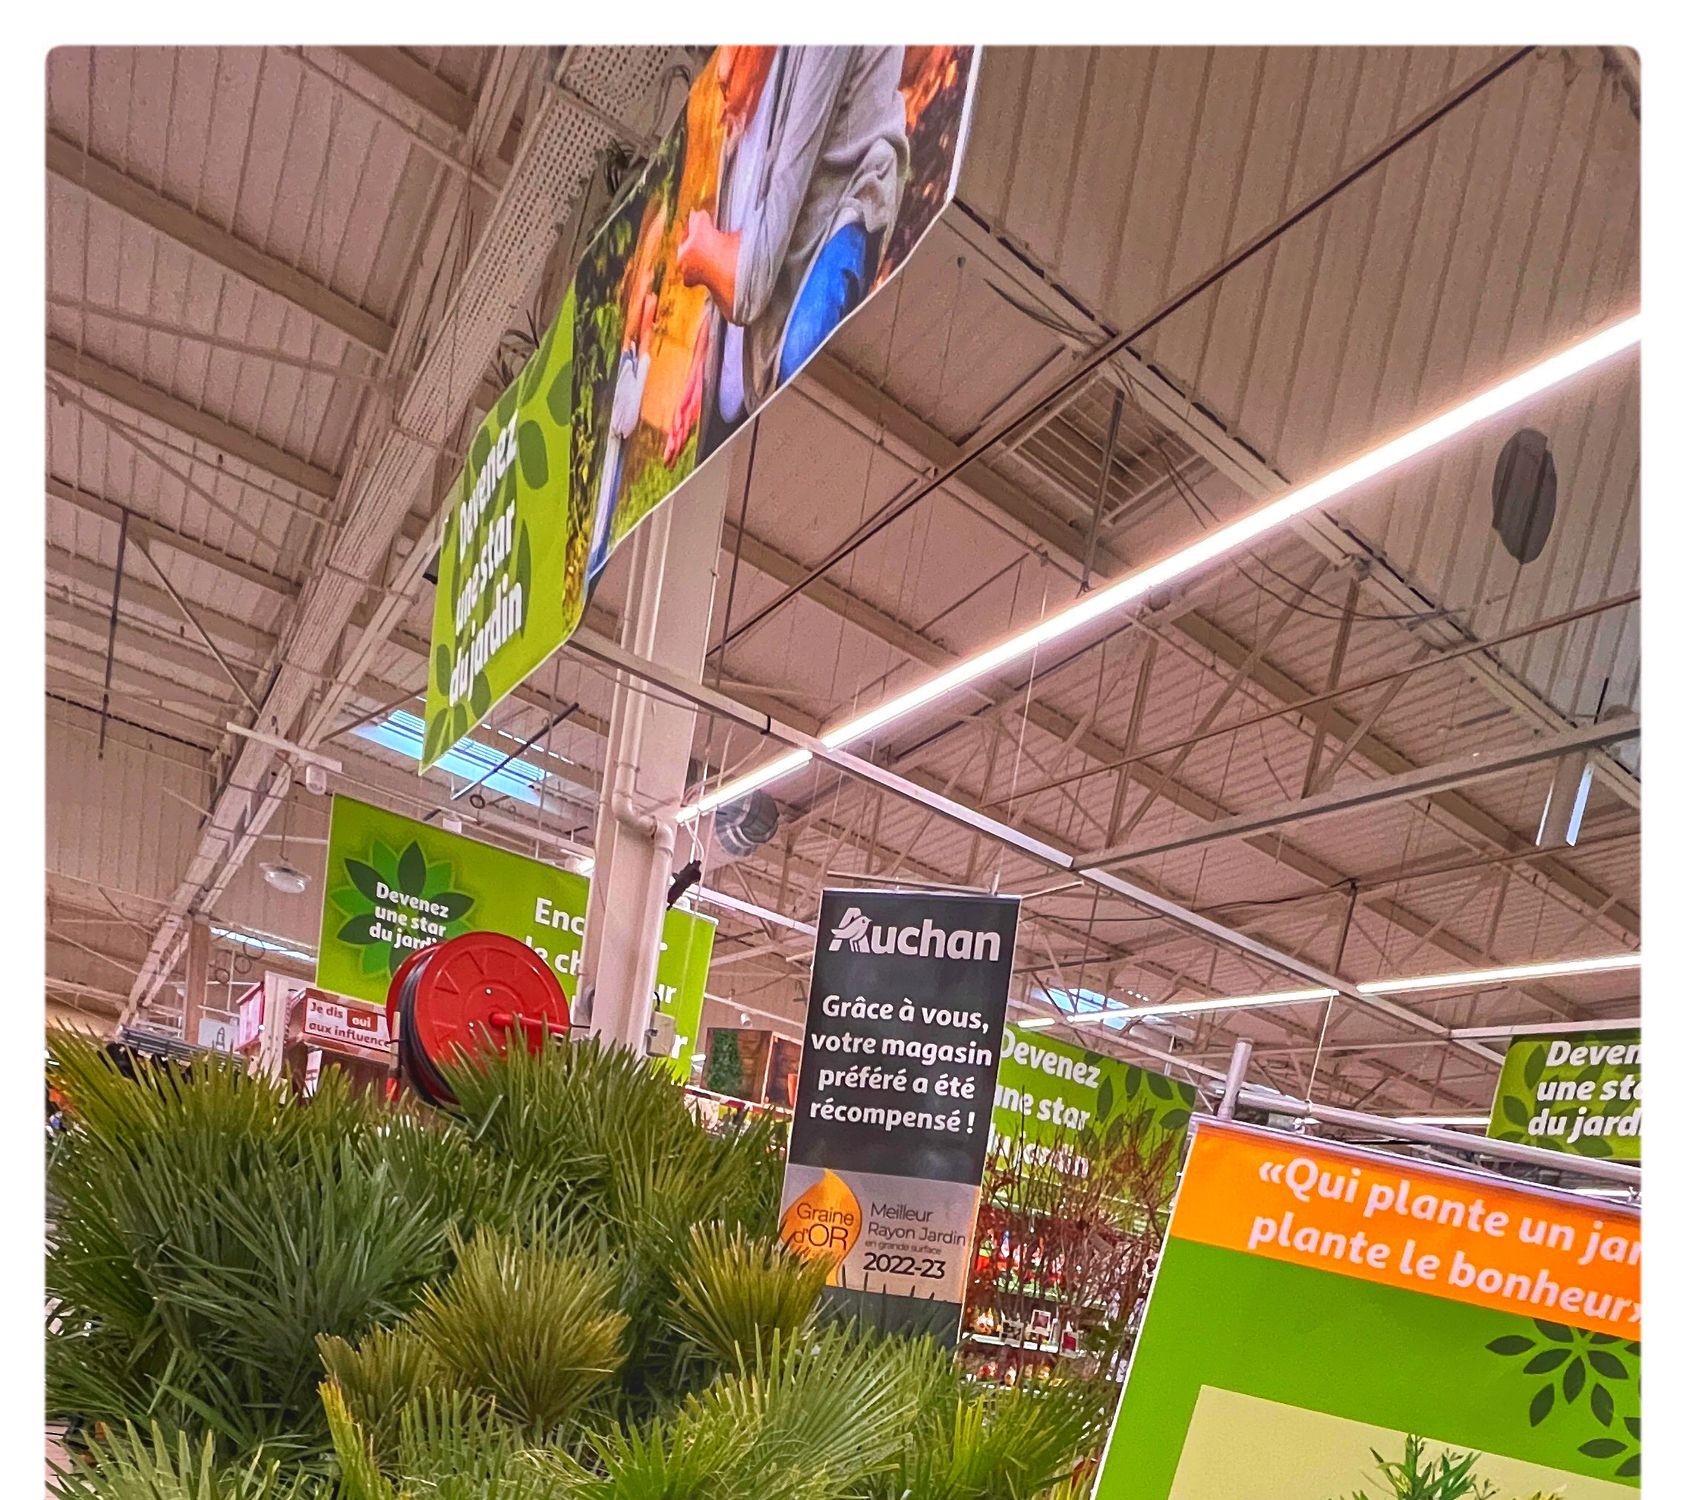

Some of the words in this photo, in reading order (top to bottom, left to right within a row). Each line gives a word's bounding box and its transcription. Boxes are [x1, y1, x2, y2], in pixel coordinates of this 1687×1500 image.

[460, 408, 518, 562] Devenez
[456, 563, 479, 637] une
[480, 499, 515, 595] star
[450, 646, 470, 707] du
[468, 573, 522, 702] jardin
[376, 881, 449, 918] Devenez
[534, 897, 586, 936] Enc
[369, 922, 393, 942] du
[375, 906, 407, 926] une
[410, 916, 446, 937] star
[829, 907, 1000, 961] Auchan
[311, 1002, 323, 1014] Je
[326, 1007, 344, 1019] dis
[352, 1017, 371, 1028] oui
[822, 995, 894, 1020] Grâce
[899, 998, 915, 1022] à
[921, 1007, 989, 1034] vous,
[309, 1023, 331, 1034] aux
[335, 1026, 390, 1048] influence
[811, 1032, 876, 1054] votre
[881, 1041, 992, 1066] magasin
[1546, 1040, 1641, 1067] Deven
[818, 1065, 907, 1091] préféré
[912, 1077, 928, 1094] a
[934, 1073, 976, 1099] été
[1537, 1080, 1596, 1101] une
[810, 1097, 961, 1132] récompensé
[1037, 1097, 1091, 1131] star
[1527, 1108, 1568, 1135] du
[1566, 1106, 1641, 1144] jard
[797, 1202, 854, 1226] Graine
[870, 1202, 934, 1222] Meilleur
[1363, 1180, 1509, 1237] plante
[1519, 1217, 1575, 1251] un
[1577, 1220, 1641, 1265] jar
[794, 1224, 848, 1250] d'OR
[865, 1240, 876, 1248] en
[878, 1241, 909, 1251] grande
[911, 1244, 942, 1255] surface
[868, 1221, 915, 1240] Rayon
[919, 1227, 966, 1246] Jardin
[1248, 1211, 1391, 1268] plante
[1400, 1239, 1441, 1280] le
[863, 1252, 946, 1279] 2022-23
